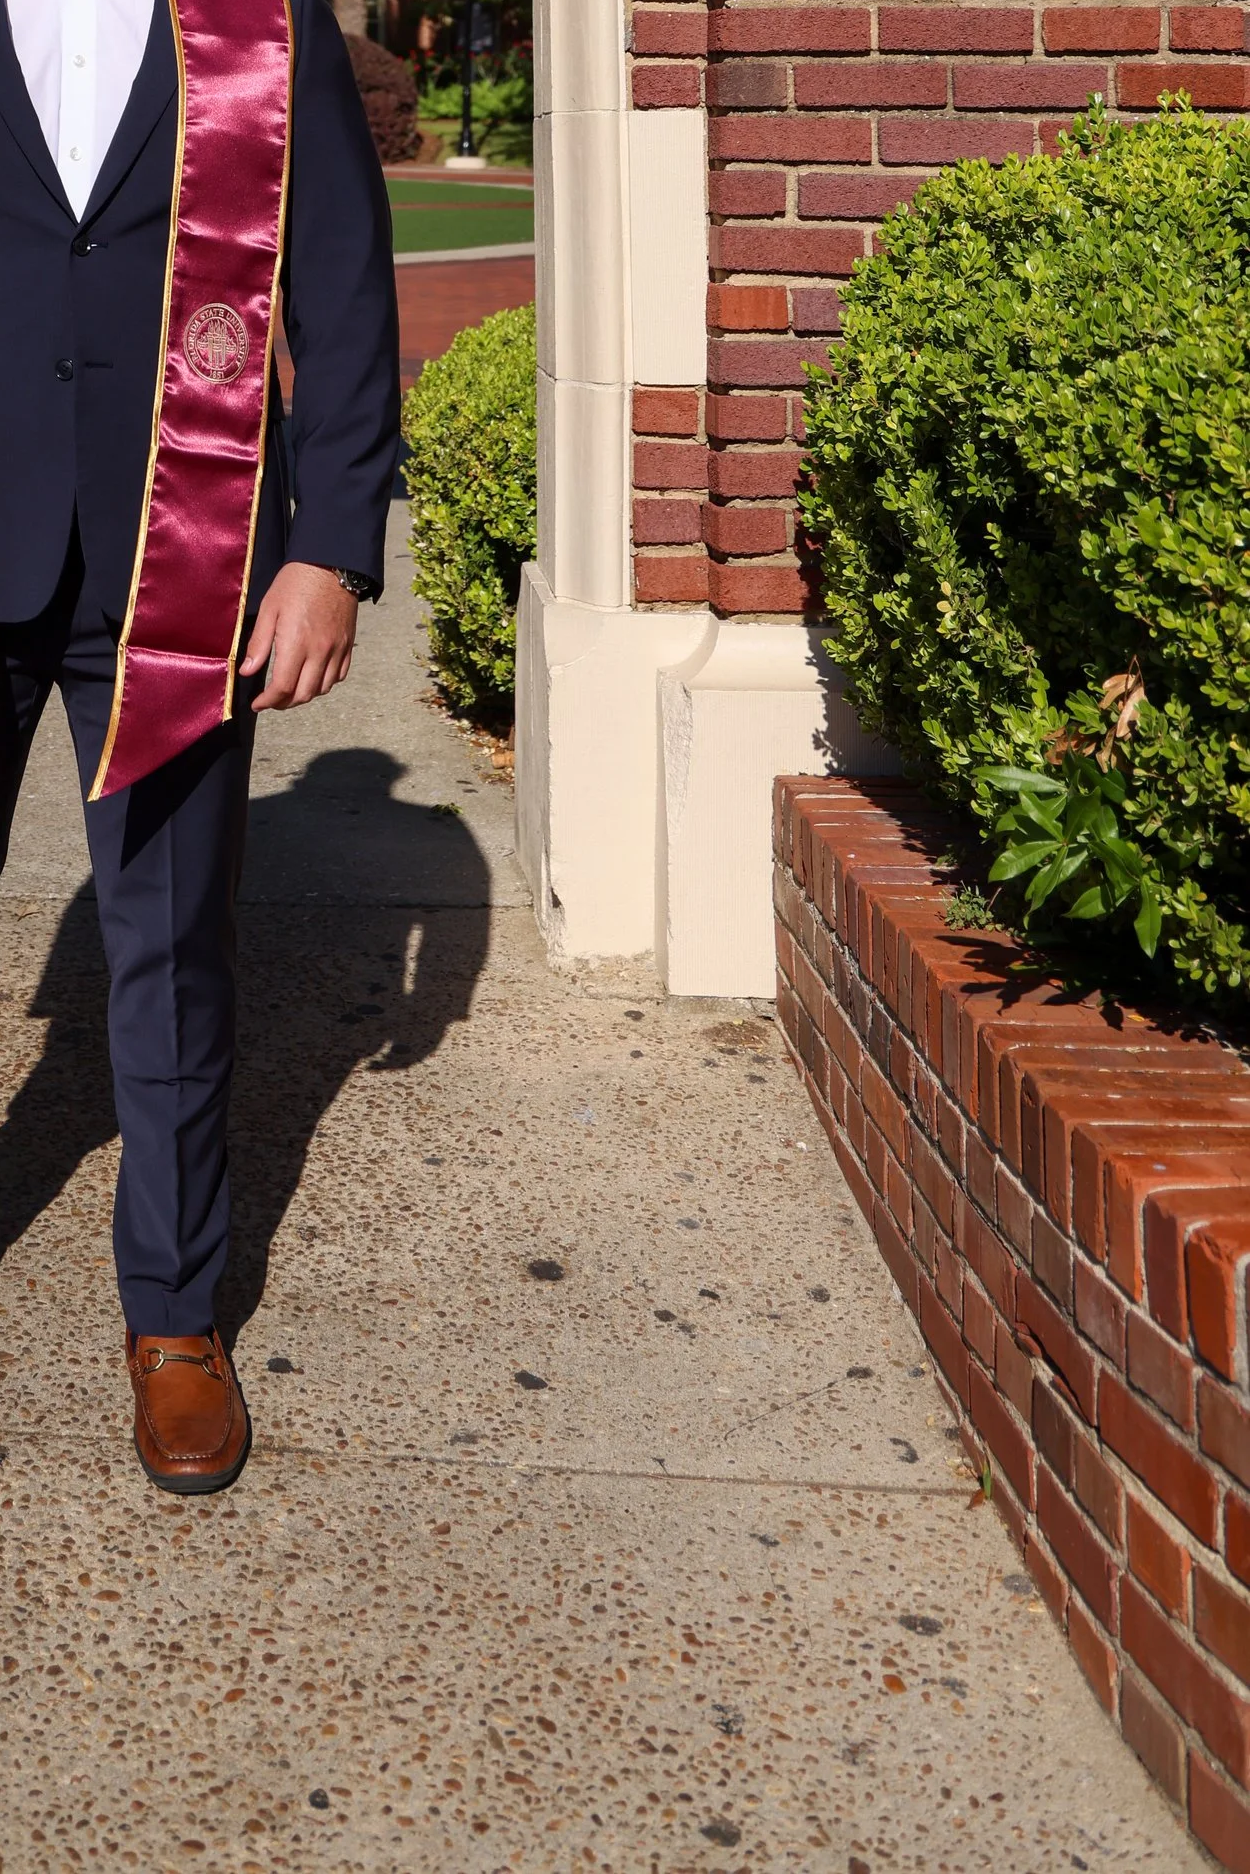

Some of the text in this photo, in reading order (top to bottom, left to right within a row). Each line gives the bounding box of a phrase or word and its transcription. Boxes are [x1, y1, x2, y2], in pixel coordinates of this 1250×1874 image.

[188, 308, 245, 367] FLORIDA STATE UNIVERSITY
